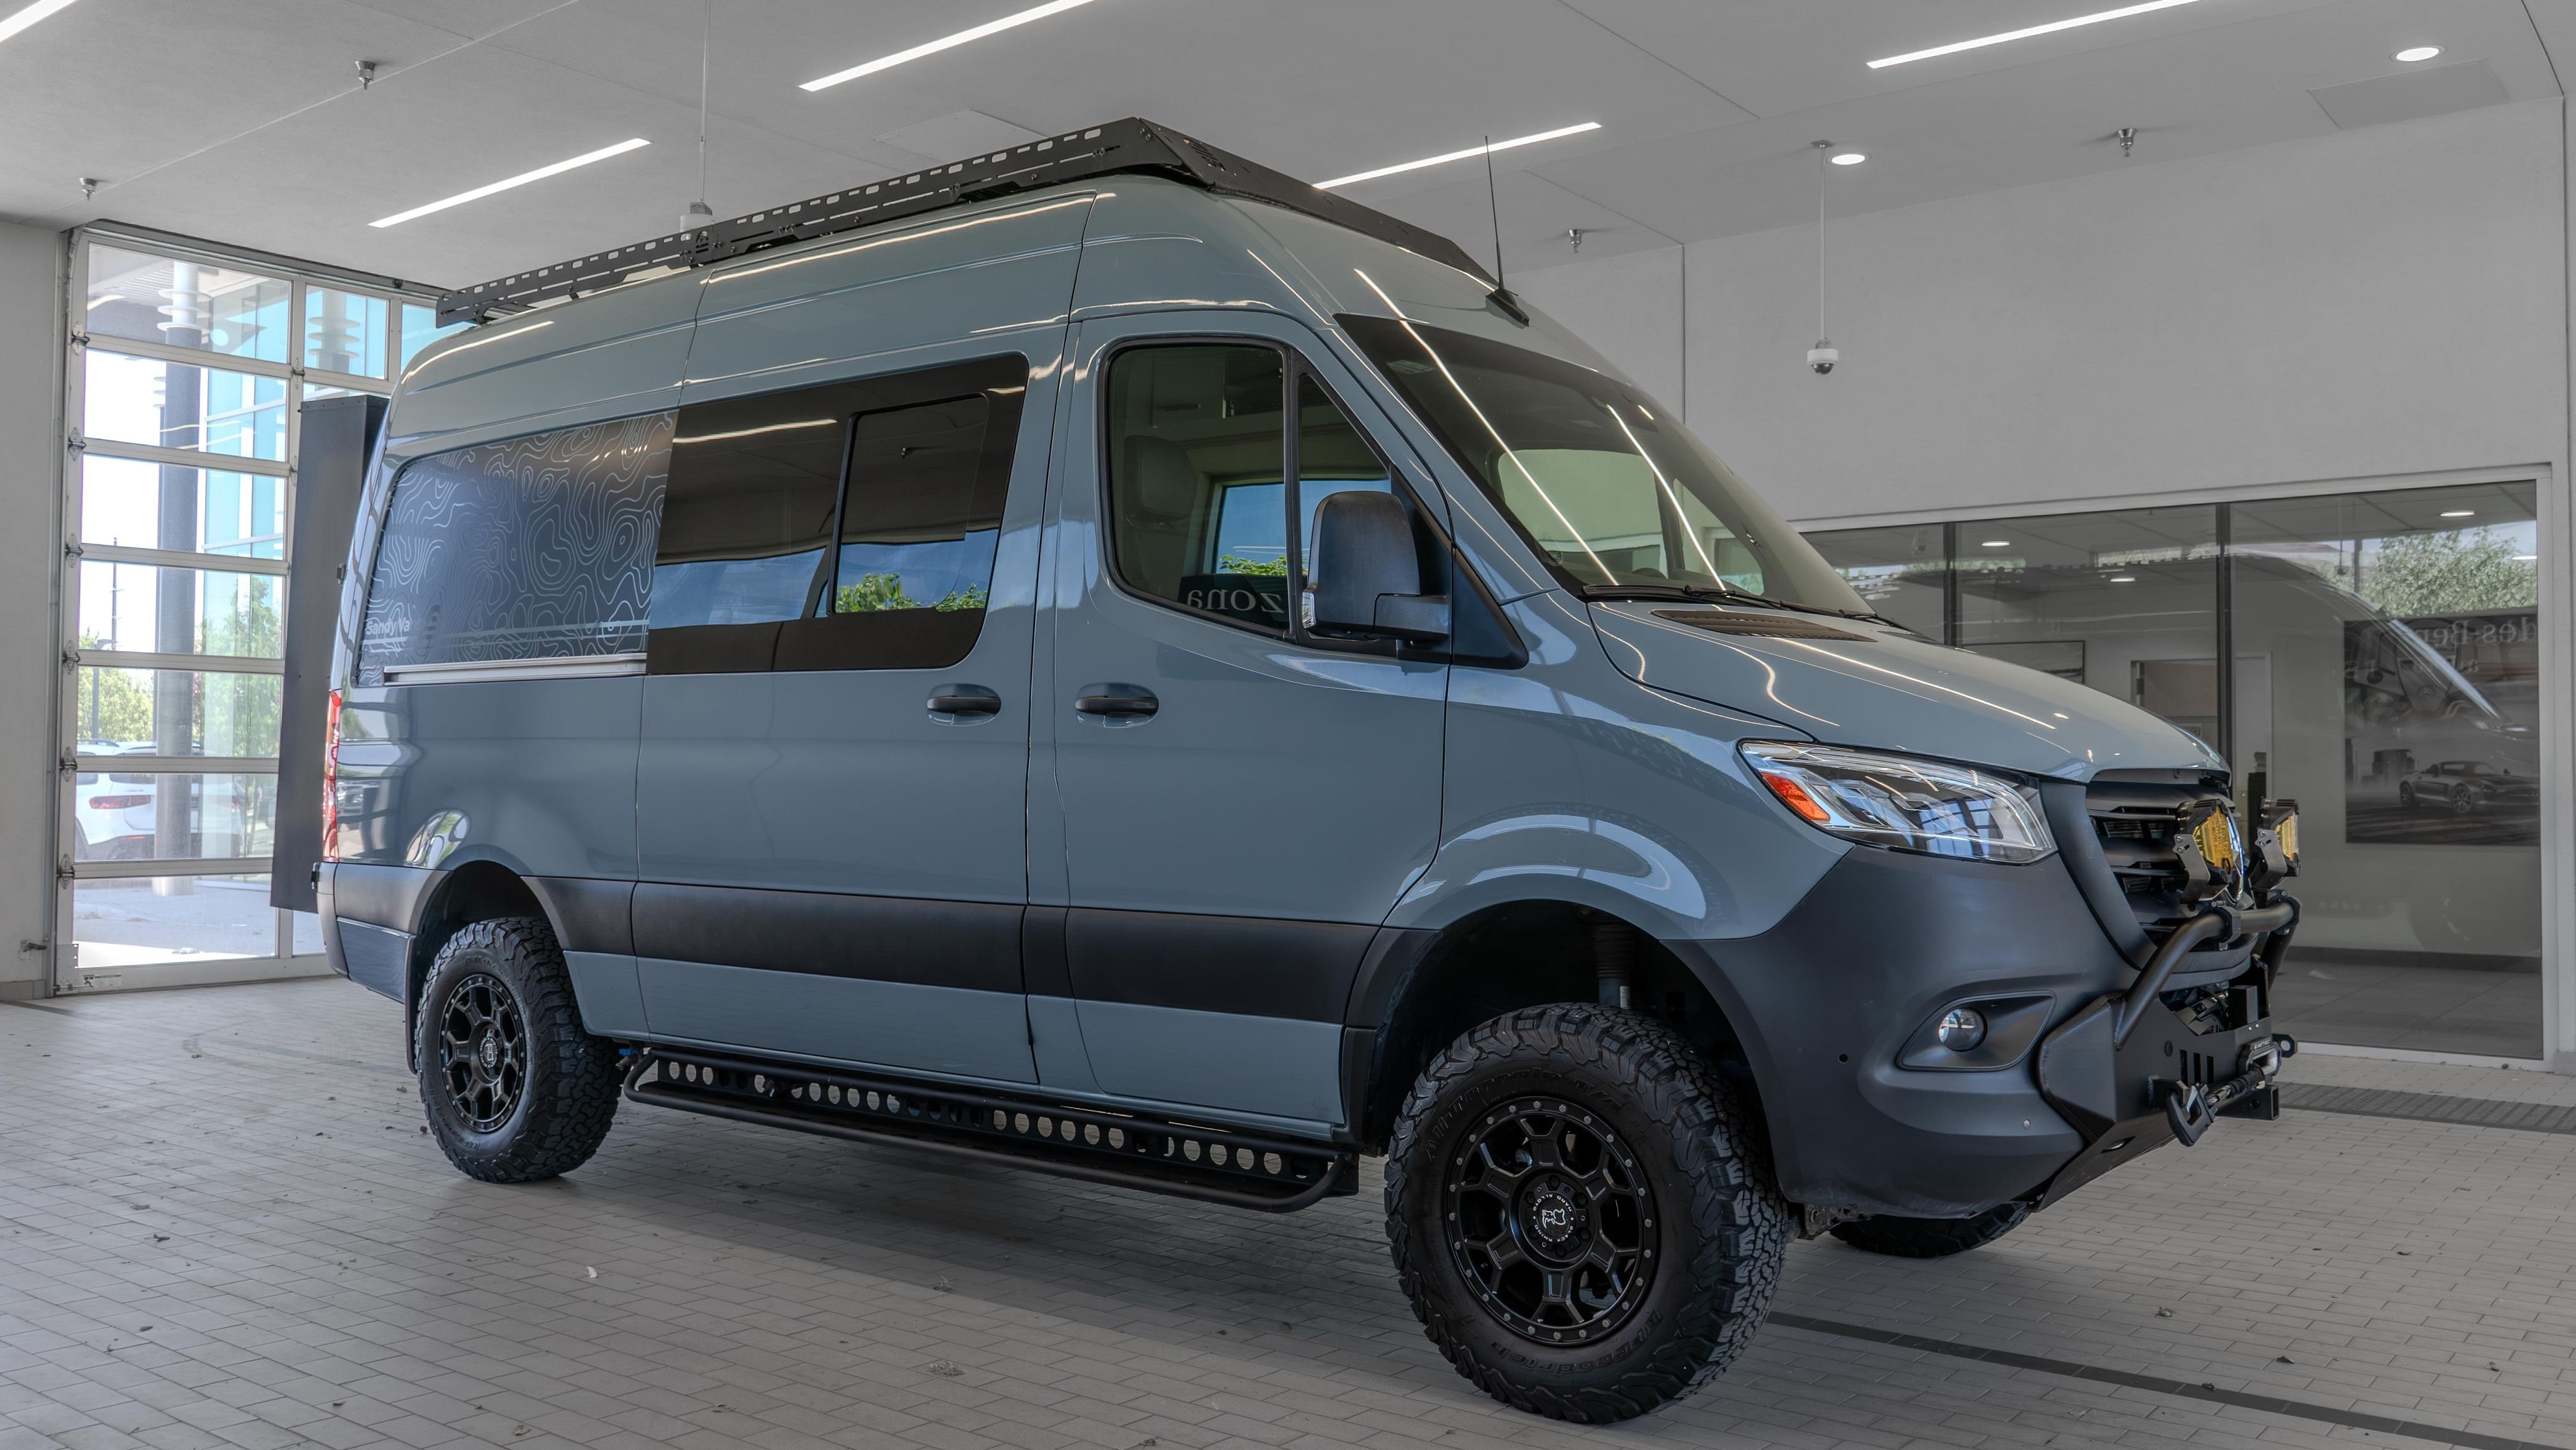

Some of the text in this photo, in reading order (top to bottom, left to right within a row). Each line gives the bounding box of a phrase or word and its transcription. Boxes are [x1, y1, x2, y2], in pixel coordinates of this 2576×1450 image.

[365, 618, 397, 636] Sandy
[1533, 1194, 1572, 1212] HARD ALLOYS
[1535, 1224, 1574, 1242] BLACK RHINO
